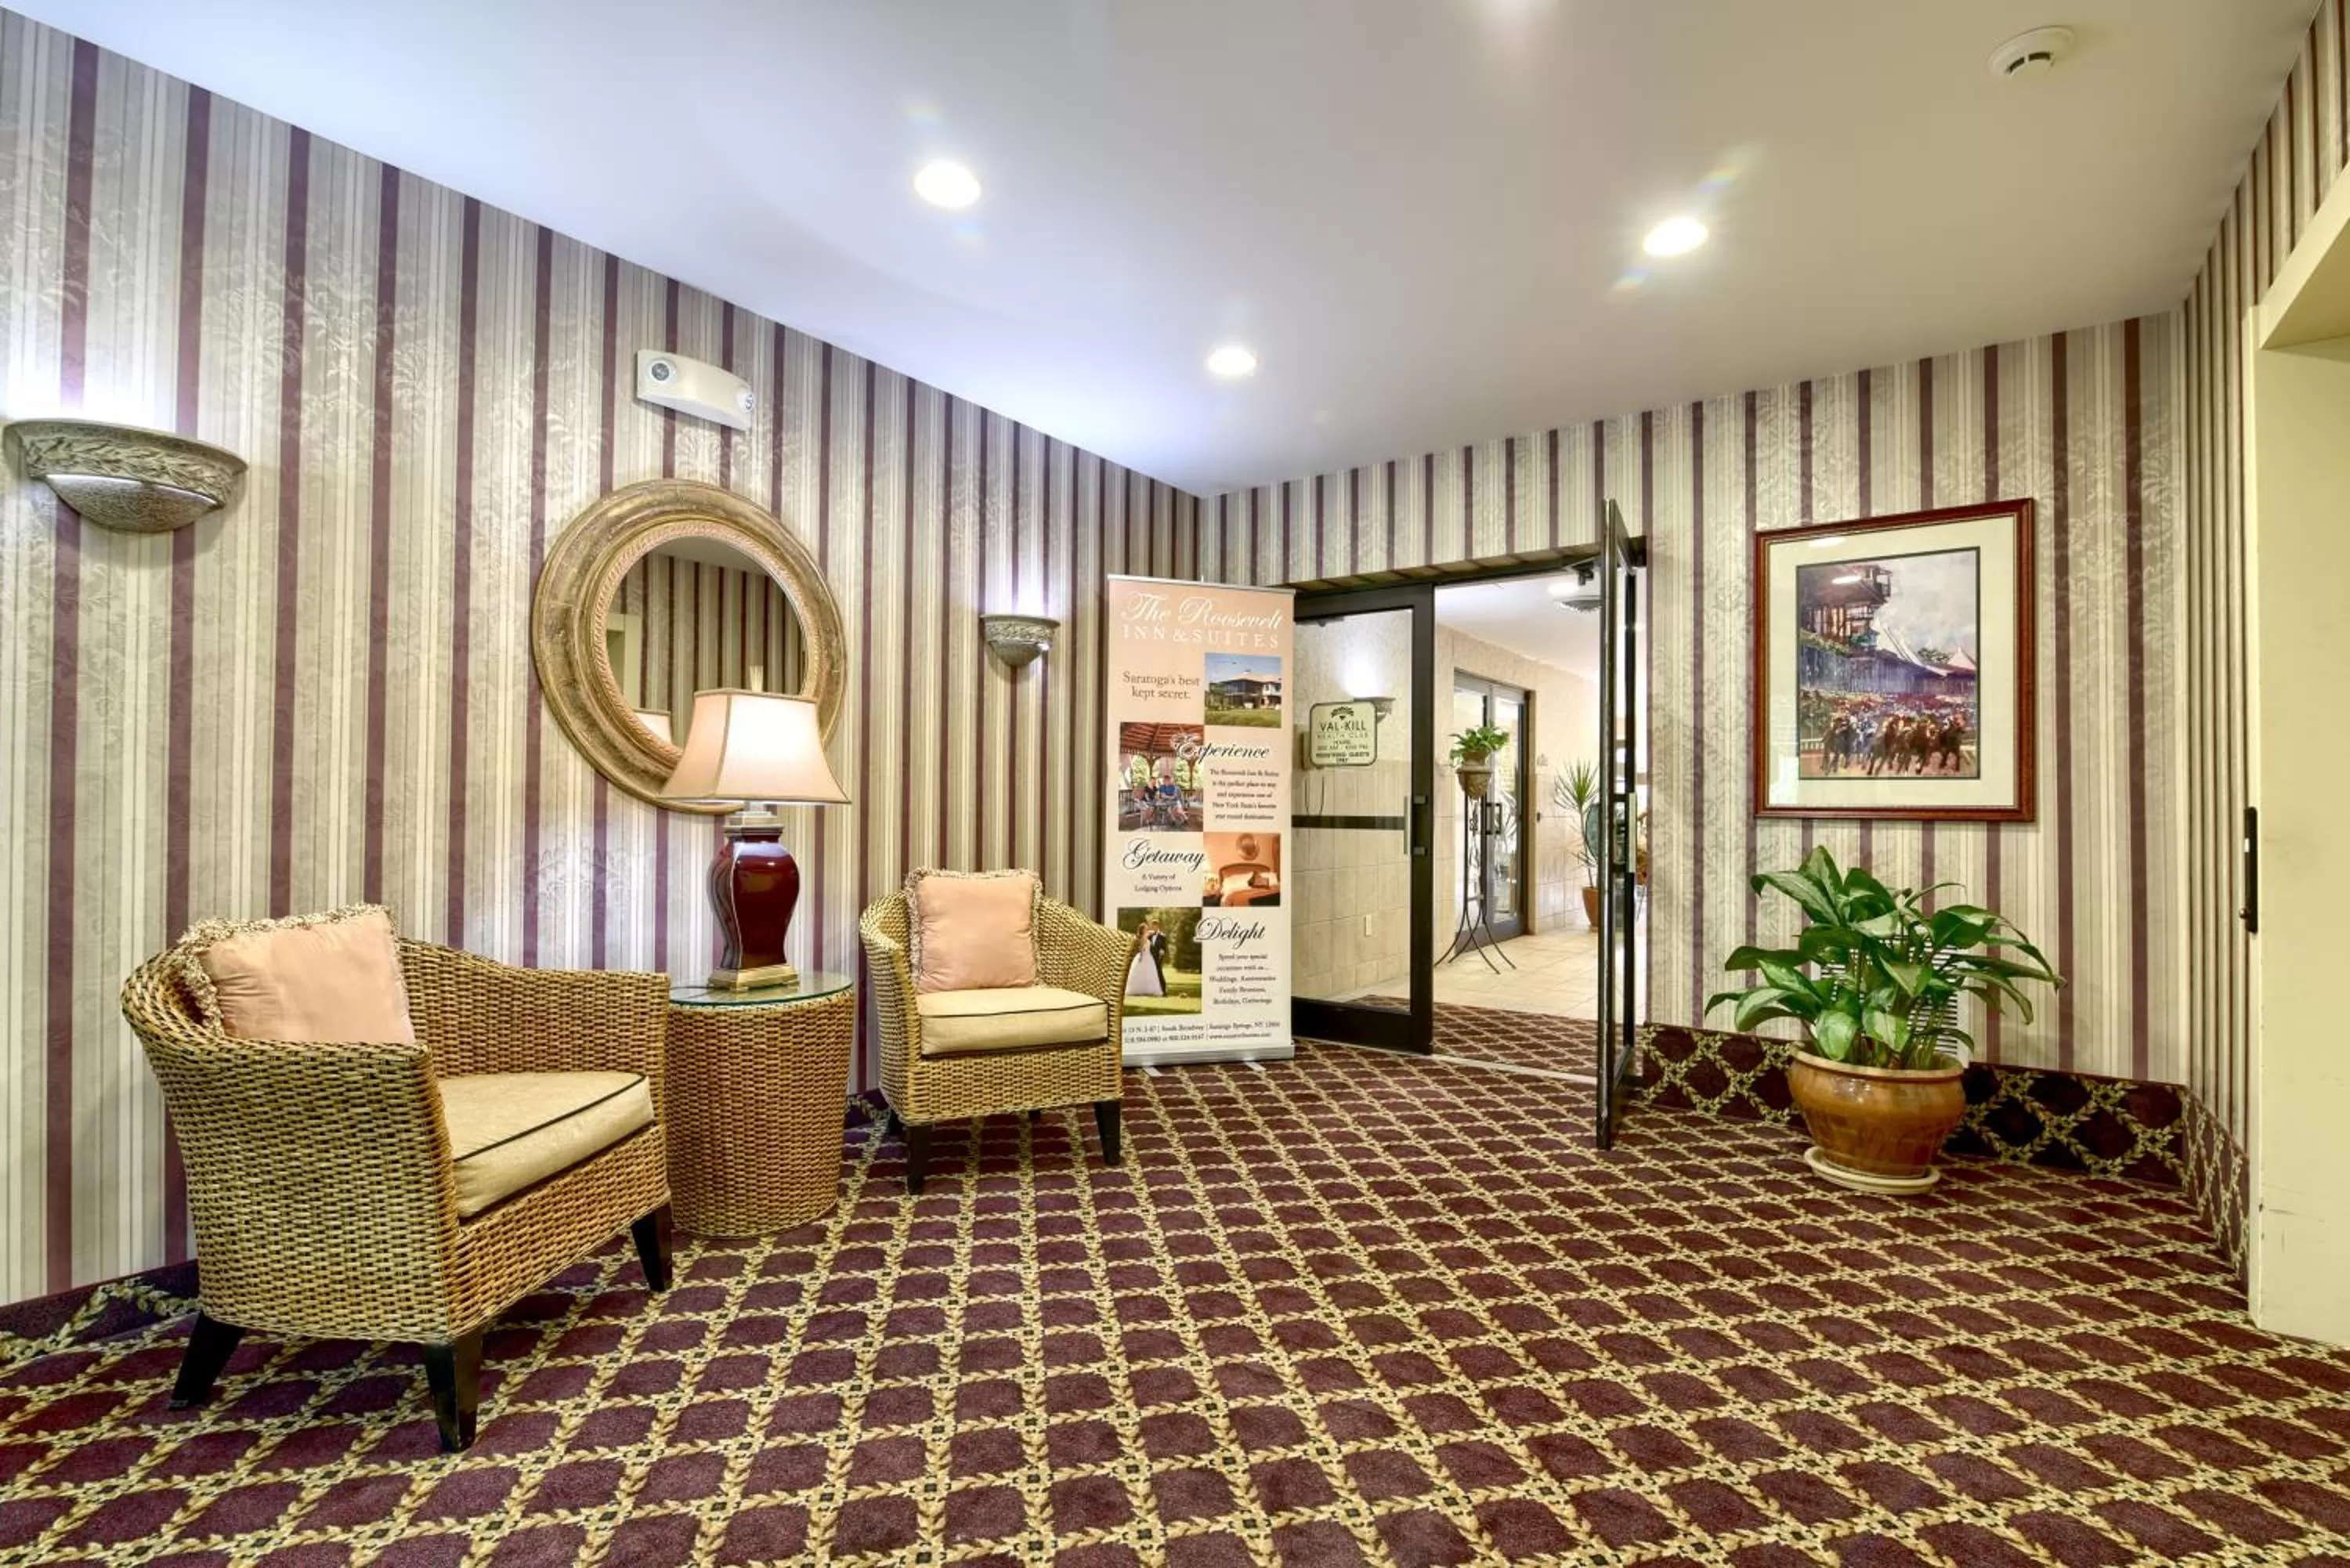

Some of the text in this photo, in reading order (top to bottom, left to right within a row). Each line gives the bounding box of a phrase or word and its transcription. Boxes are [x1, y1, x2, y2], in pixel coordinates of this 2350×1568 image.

[1120, 592, 1283, 629] The Roosevelt
[1123, 625, 1278, 649] INN & SUITES
[1123, 670, 1200, 687] Saratoga's best
[1132, 686, 1191, 699] kept secret.
[1320, 721, 1366, 732] VAL-KILL
[1173, 734, 1270, 764] Experience
[1123, 837, 1204, 873] Getaway
[1134, 884, 1159, 893] Lodging
[1195, 916, 1265, 949] Delight
[1178, 1023, 1204, 1031] Broadway
